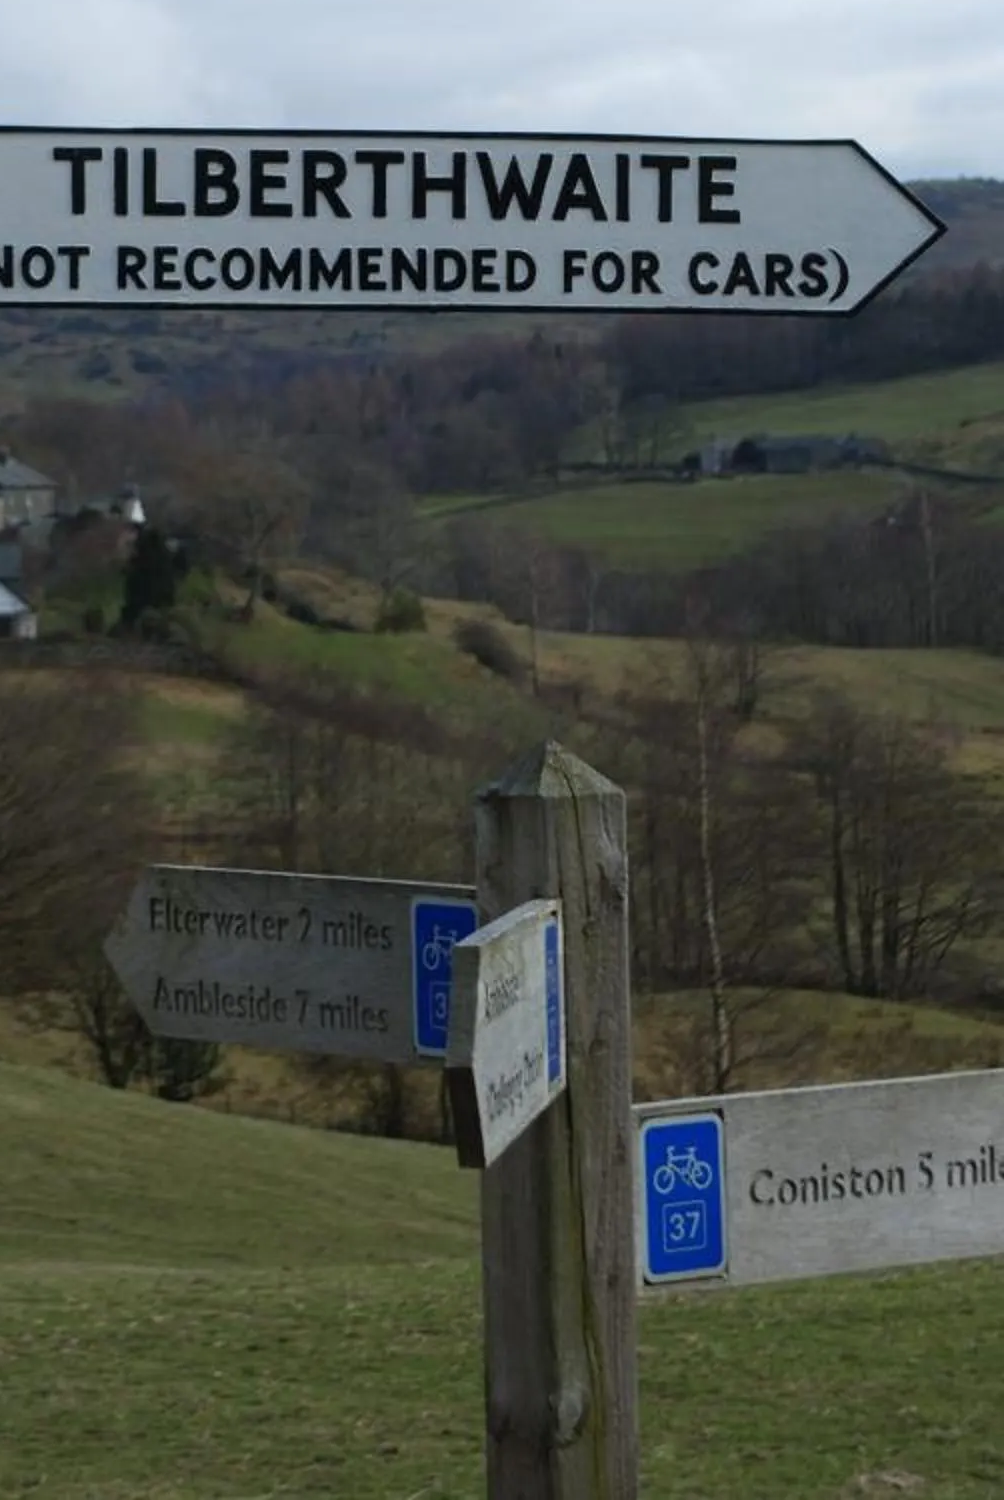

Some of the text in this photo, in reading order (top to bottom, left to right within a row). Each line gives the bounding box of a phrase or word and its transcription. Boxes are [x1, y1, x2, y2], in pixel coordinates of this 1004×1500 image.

[52, 147, 741, 224] TILBERTHWAITE
[117, 245, 537, 293] RECOMMENDED
[563, 249, 661, 295] FOR
[688, 248, 849, 302] CARS)
[149, 896, 290, 942] Elterwater
[322, 911, 393, 950] miles
[153, 976, 389, 1033] Ambleside 7 miles
[434, 991, 447, 1019] 3
[750, 1163, 906, 1206] Coniston
[917, 1150, 934, 1190] 5
[668, 1210, 701, 1242] 37
